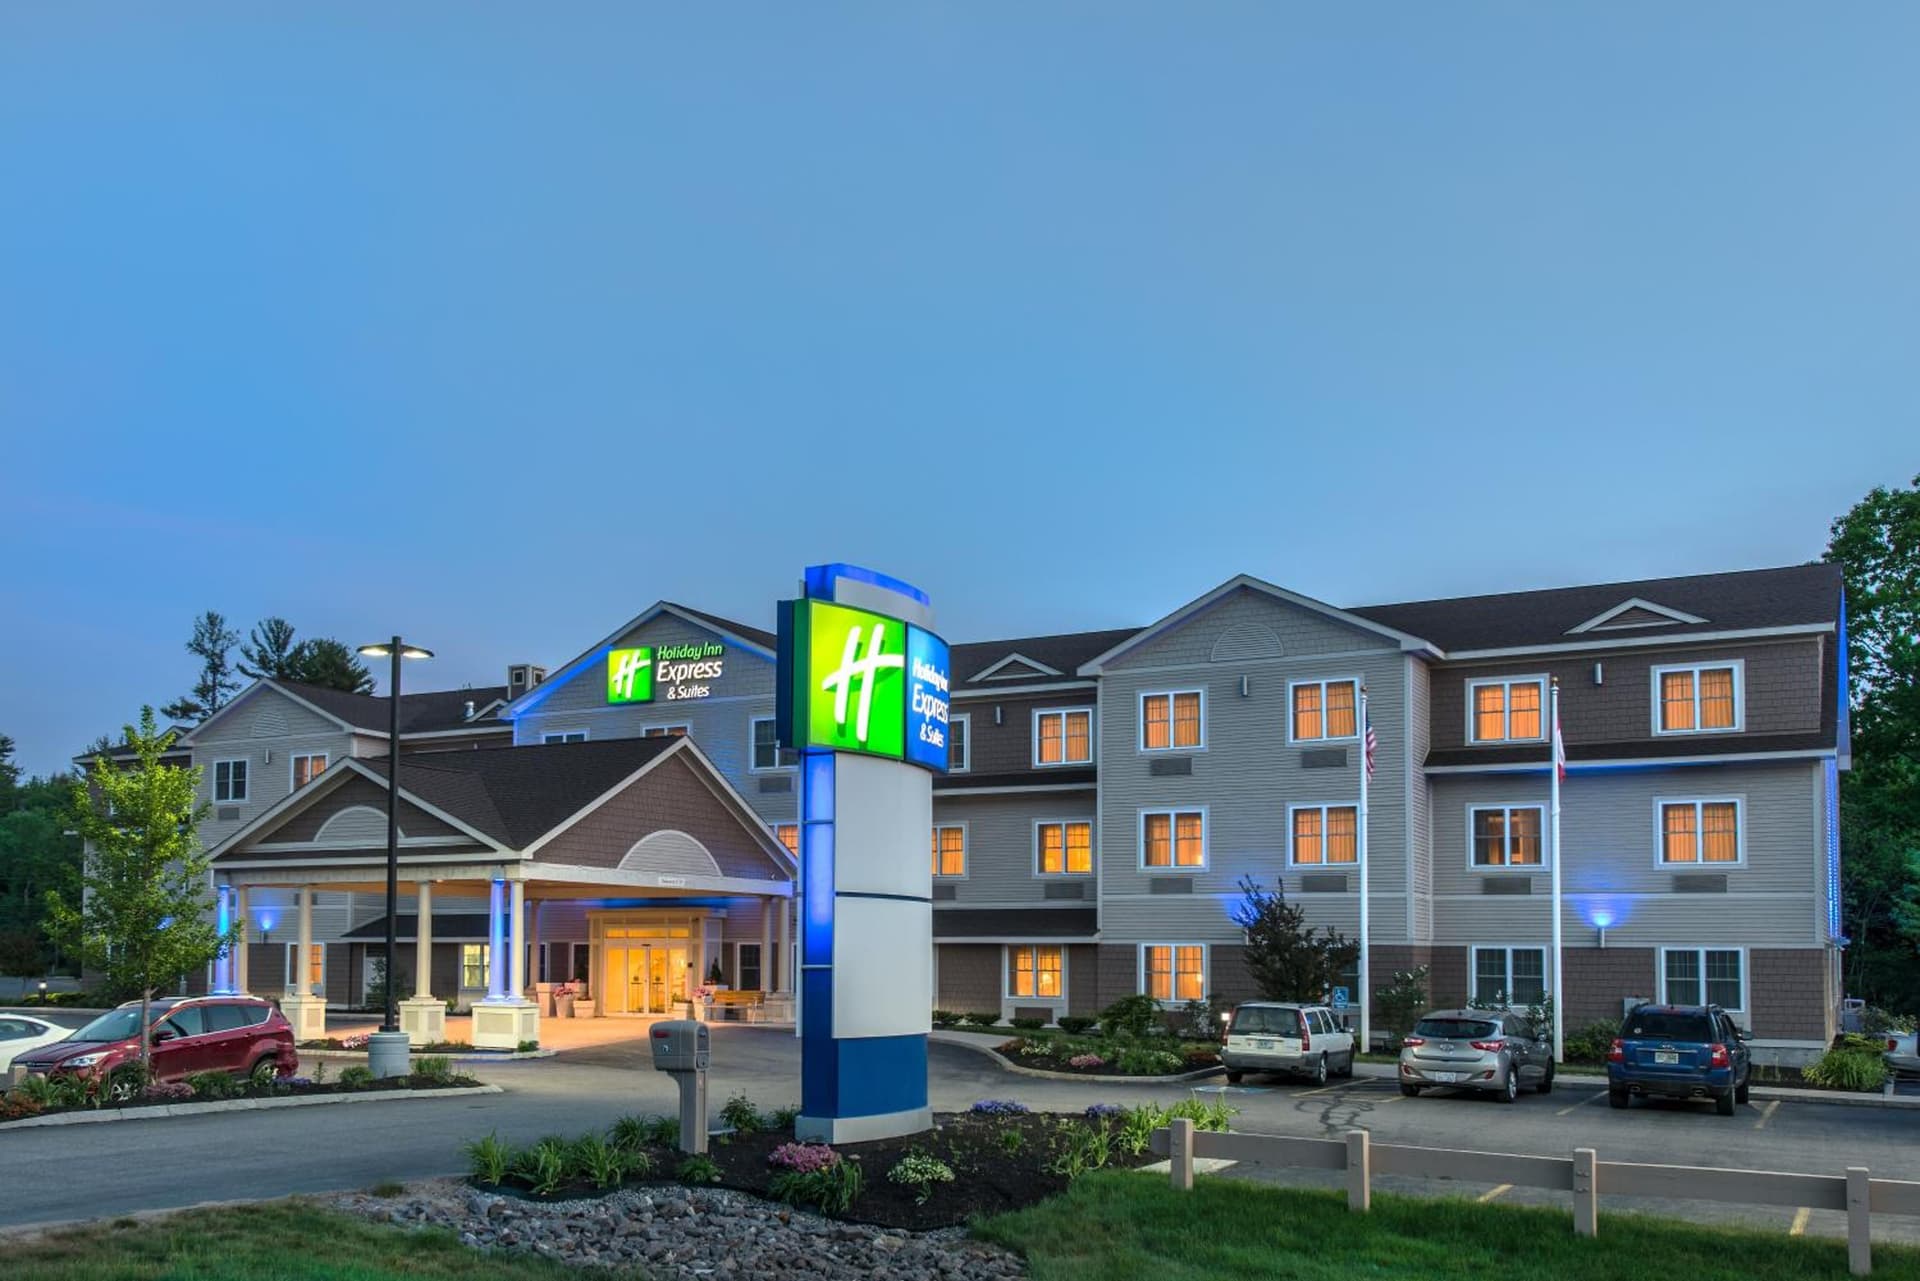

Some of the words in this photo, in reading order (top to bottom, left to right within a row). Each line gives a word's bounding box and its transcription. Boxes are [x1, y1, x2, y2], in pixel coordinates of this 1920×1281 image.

[657, 643, 702, 660] Holiday
[703, 641, 723, 656] Inn
[656, 660, 723, 685] Express
[912, 656, 941, 691] Holiday
[667, 687, 676, 700] &
[677, 684, 710, 698] Suites
[912, 683, 948, 725] Express
[920, 722, 927, 741] &
